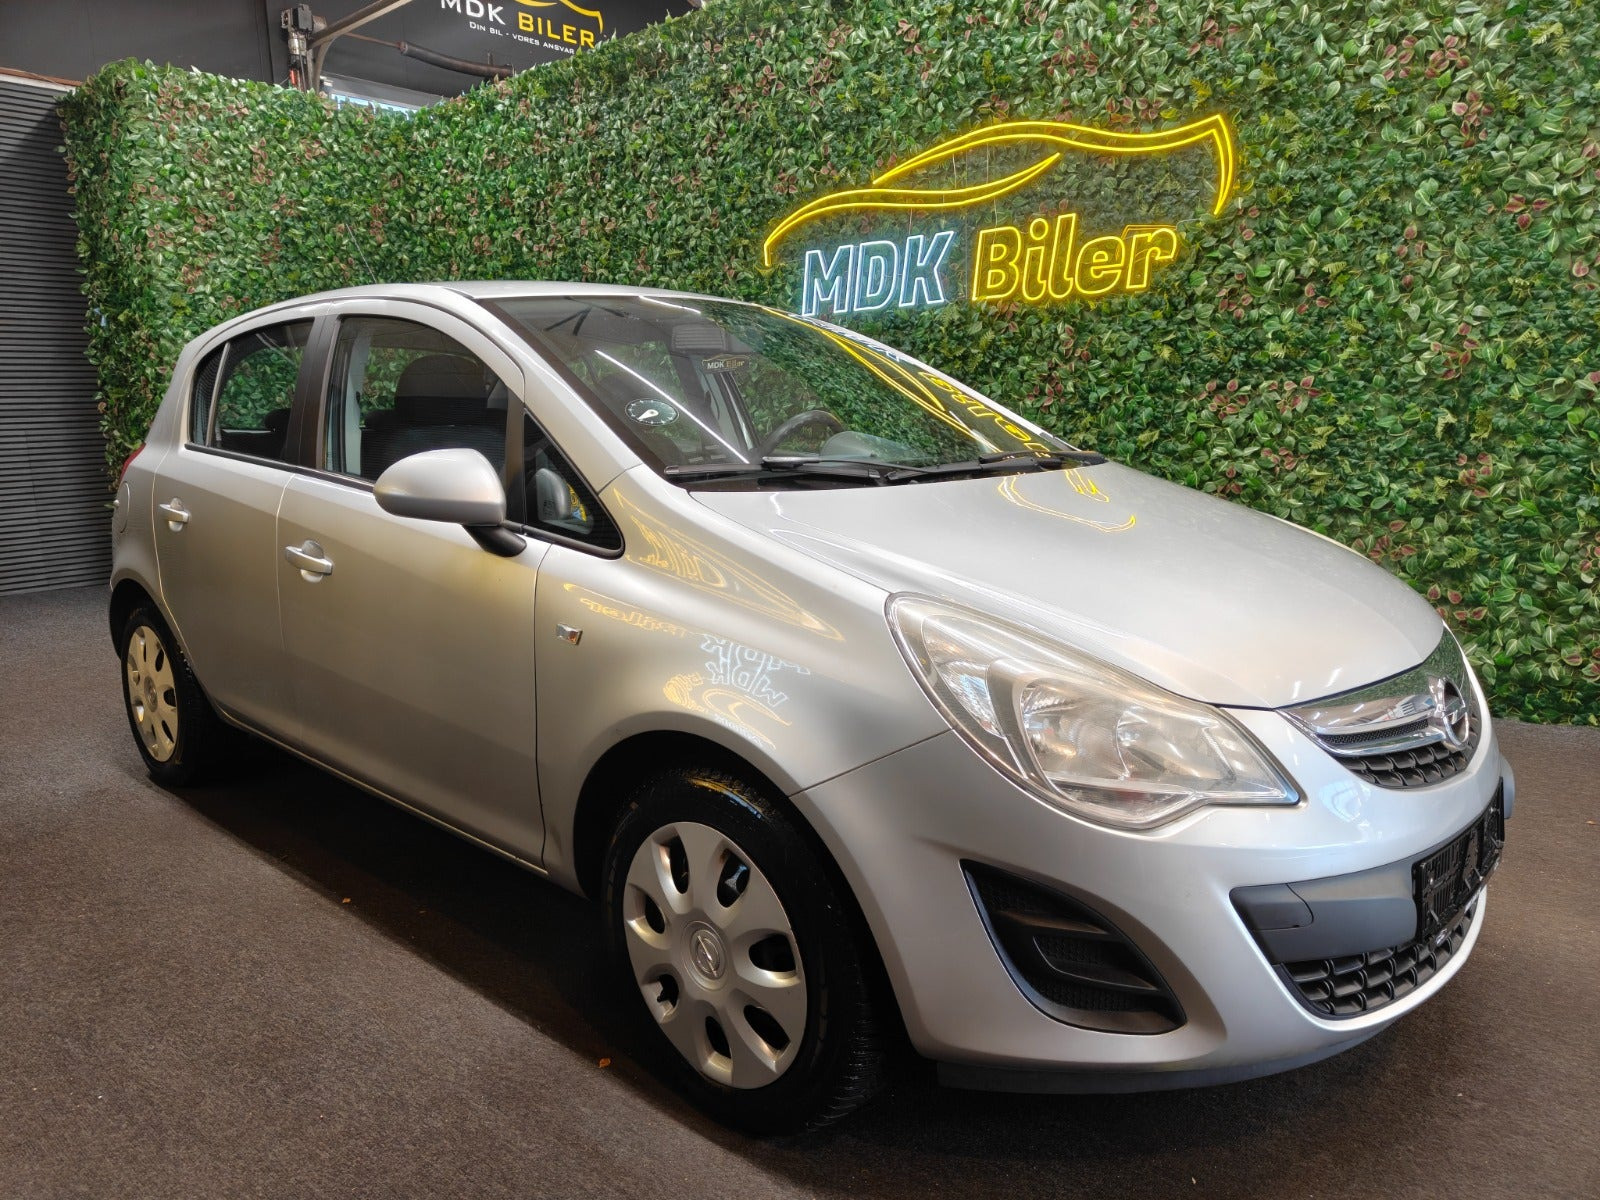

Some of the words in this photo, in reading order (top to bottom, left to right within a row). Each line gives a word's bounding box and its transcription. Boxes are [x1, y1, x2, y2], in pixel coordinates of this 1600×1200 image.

[469, 21, 486, 32] DIN
[489, 27, 503, 36] BIL
[512, 33, 540, 46] VORES
[543, 41, 575, 55] ANSVAR
[518, 11, 595, 49] BILER
[801, 230, 955, 316] MDK
[971, 212, 1178, 302] Biler
[707, 361, 724, 369] MDK
